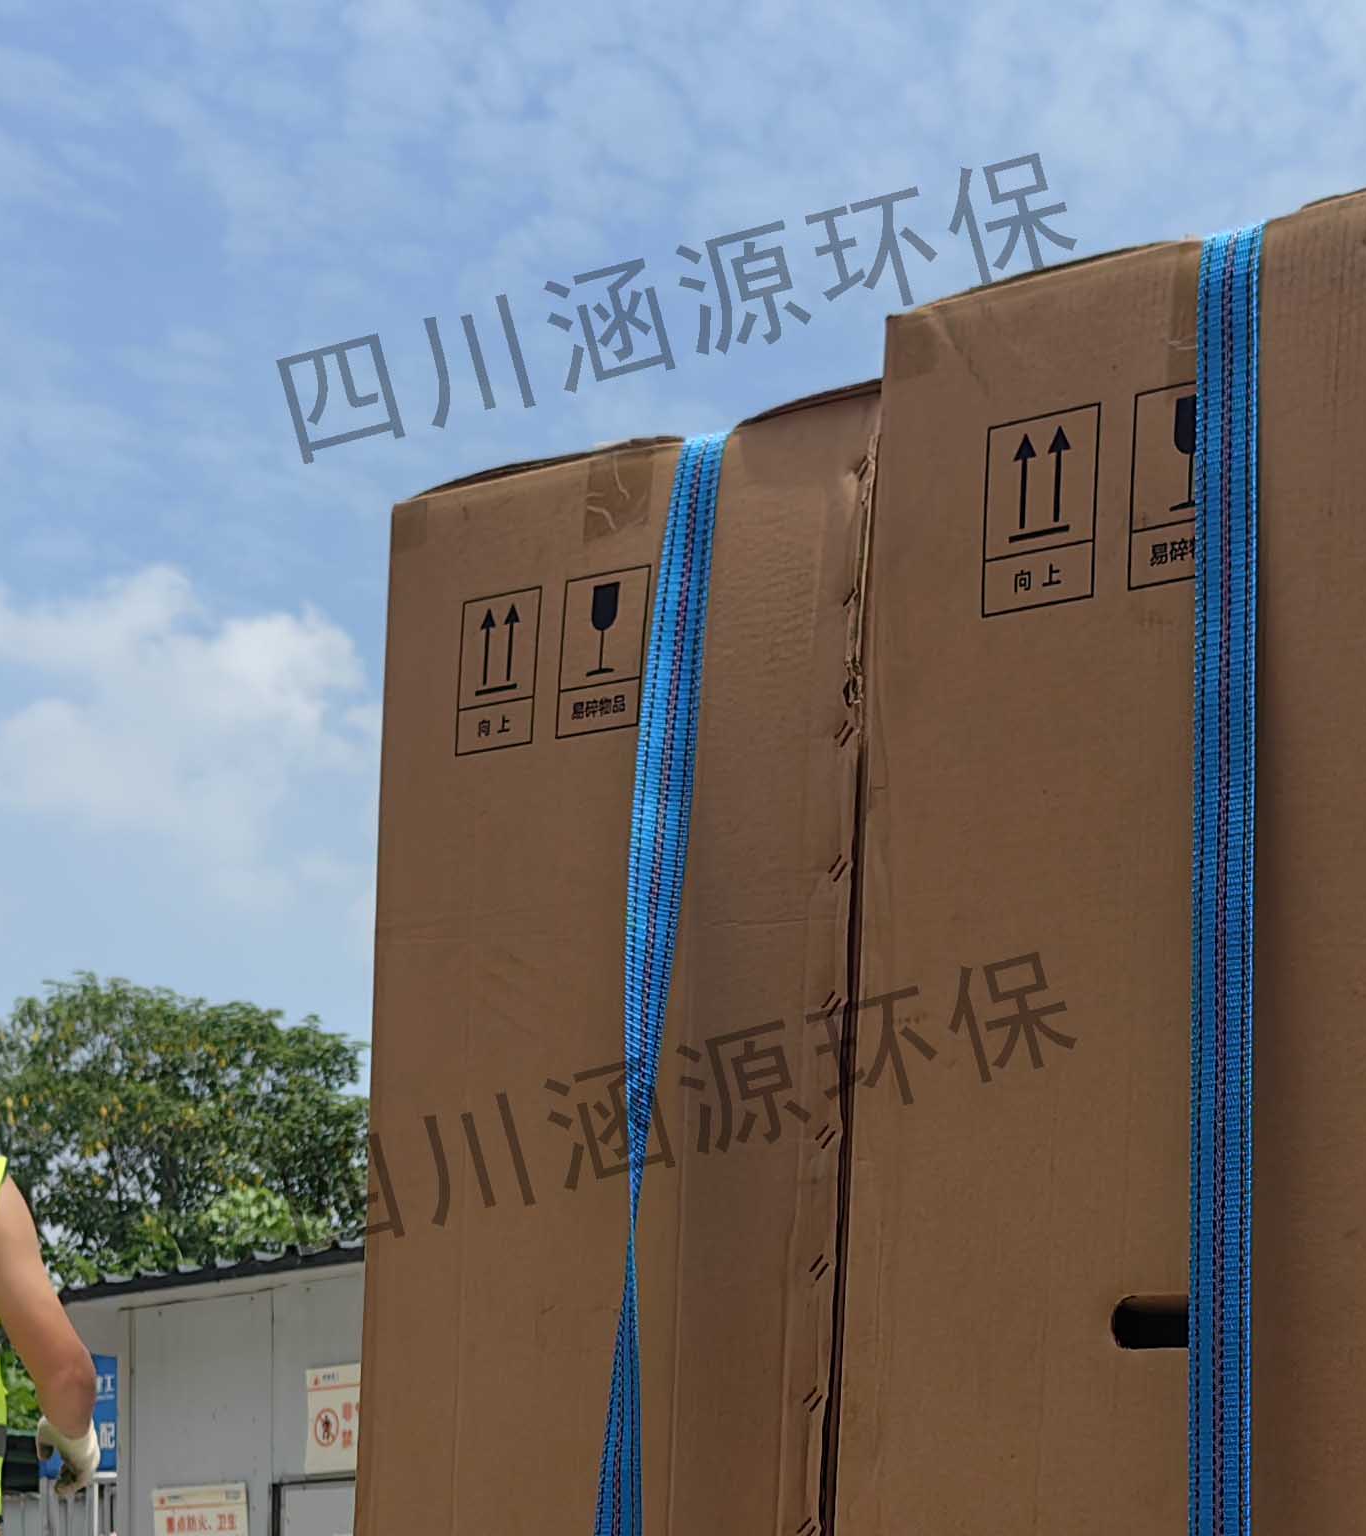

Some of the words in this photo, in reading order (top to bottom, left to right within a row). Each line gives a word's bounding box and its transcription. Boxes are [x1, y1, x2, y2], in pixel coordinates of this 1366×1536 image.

[1014, 564, 1062, 594] 向上
[571, 694, 626, 720] 易碎物品
[477, 715, 511, 738] 向上
